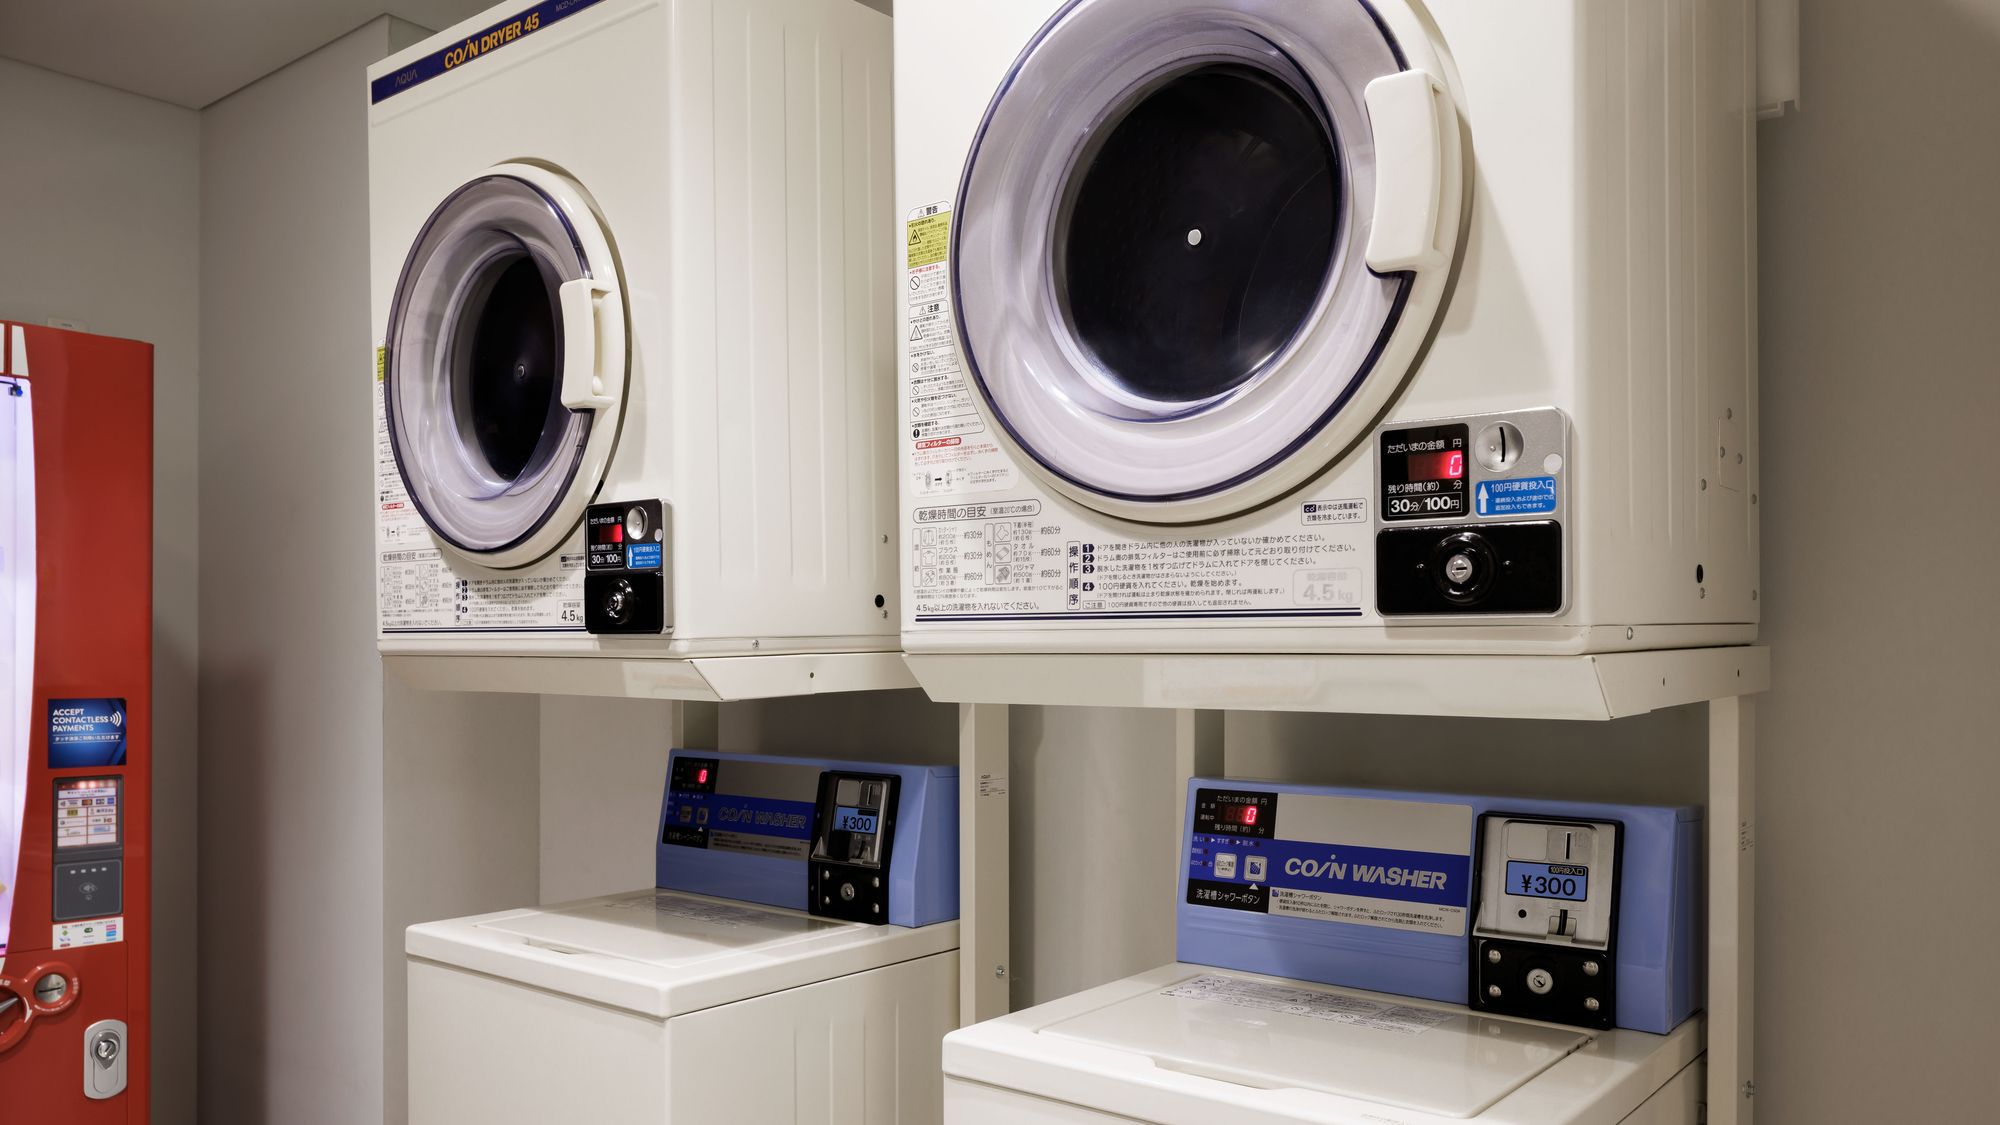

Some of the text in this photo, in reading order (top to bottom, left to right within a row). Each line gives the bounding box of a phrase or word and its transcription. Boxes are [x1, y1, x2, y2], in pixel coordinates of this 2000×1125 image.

[444, 12, 540, 70] COIN DRYER 45
[395, 68, 418, 88] AQUA
[927, 303, 940, 313] 注意
[1387, 438, 1462, 454] ただいまの金額 円
[1449, 454, 1463, 476] 0
[1453, 480, 1463, 490] 分
[918, 506, 987, 521] 乾燥時間の目安
[1068, 545, 1079, 606] 操作順序
[52, 715, 109, 725] CONTACTLESS
[53, 708, 84, 717] ACCEPT
[52, 724, 94, 732] PAYMENTS
[699, 769, 708, 784] 0
[1216, 795, 1268, 806] ただいまの金額 円
[719, 803, 754, 824] COIN
[755, 810, 807, 830] WASHER
[842, 815, 872, 831] ¥300
[1246, 807, 1257, 823] 0
[1284, 854, 1448, 891] COIN WASHER
[1520, 874, 1577, 896] ¥300
[1195, 888, 1261, 905] 洗濯槽シャワーボタン
